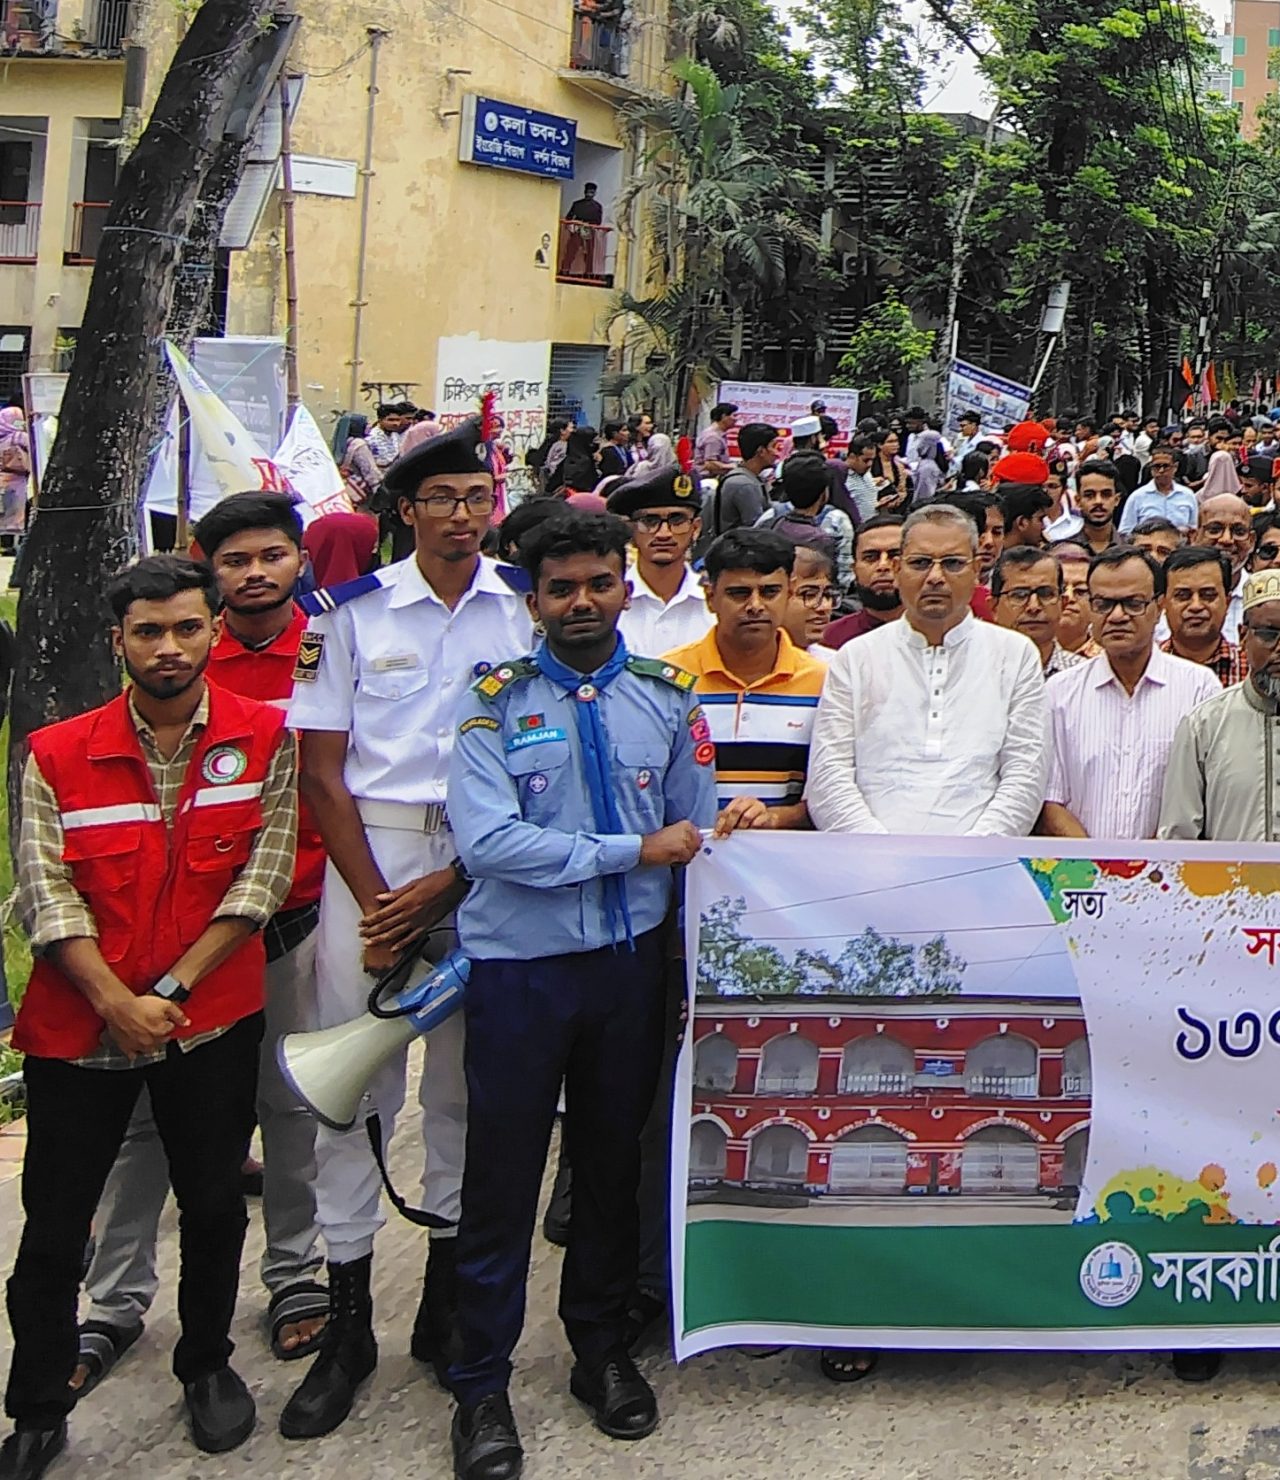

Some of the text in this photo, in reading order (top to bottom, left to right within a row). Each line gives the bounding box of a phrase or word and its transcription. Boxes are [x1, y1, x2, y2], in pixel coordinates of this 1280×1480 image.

[498, 114, 569, 146] কলা ভবন-১
[512, 730, 558, 747] RAMJAN
[1063, 889, 1107, 921] সত্য
